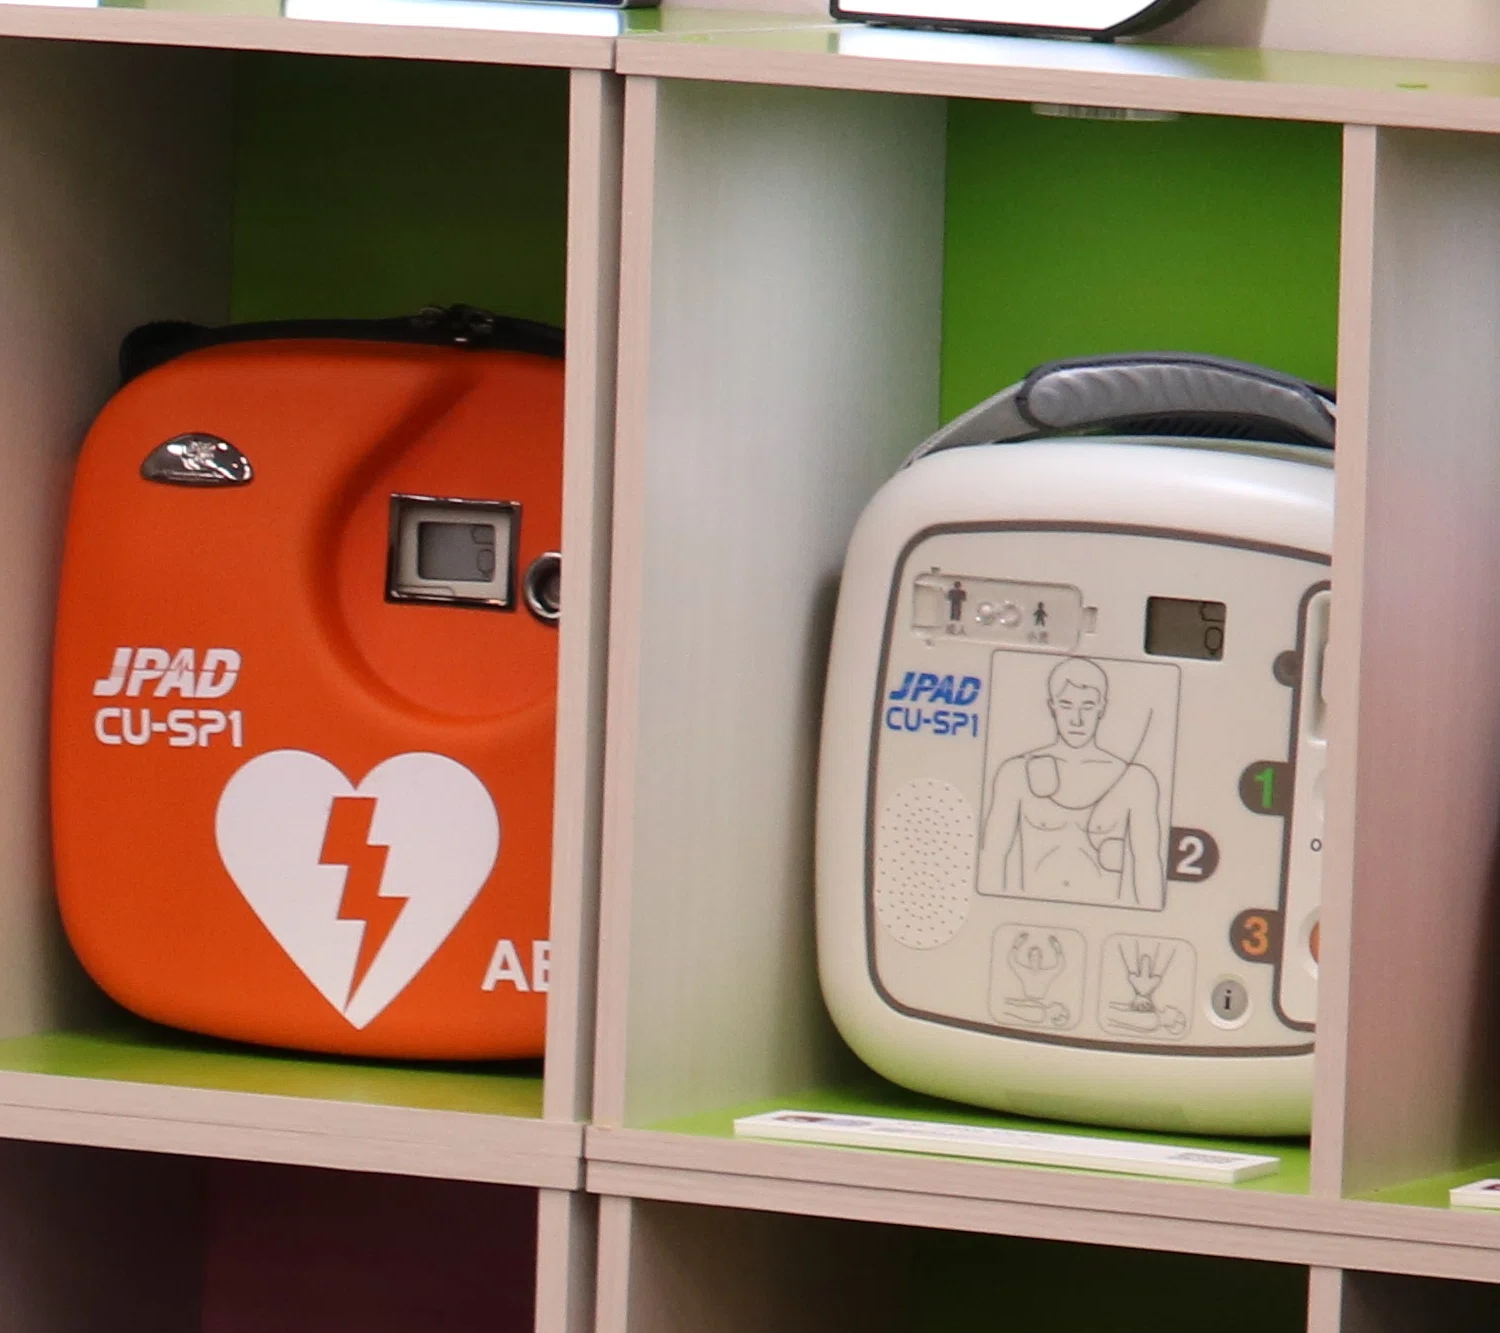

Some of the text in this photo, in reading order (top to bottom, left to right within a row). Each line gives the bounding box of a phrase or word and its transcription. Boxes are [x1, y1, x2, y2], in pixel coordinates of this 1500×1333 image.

[92, 646, 242, 698] JPAD
[889, 671, 982, 706] JPAD
[94, 706, 243, 747] CU-SP1
[886, 706, 979, 738] CU-SP1
[1254, 766, 1275, 808] 1
[1177, 836, 1205, 876] 2
[1242, 915, 1269, 955] 3
